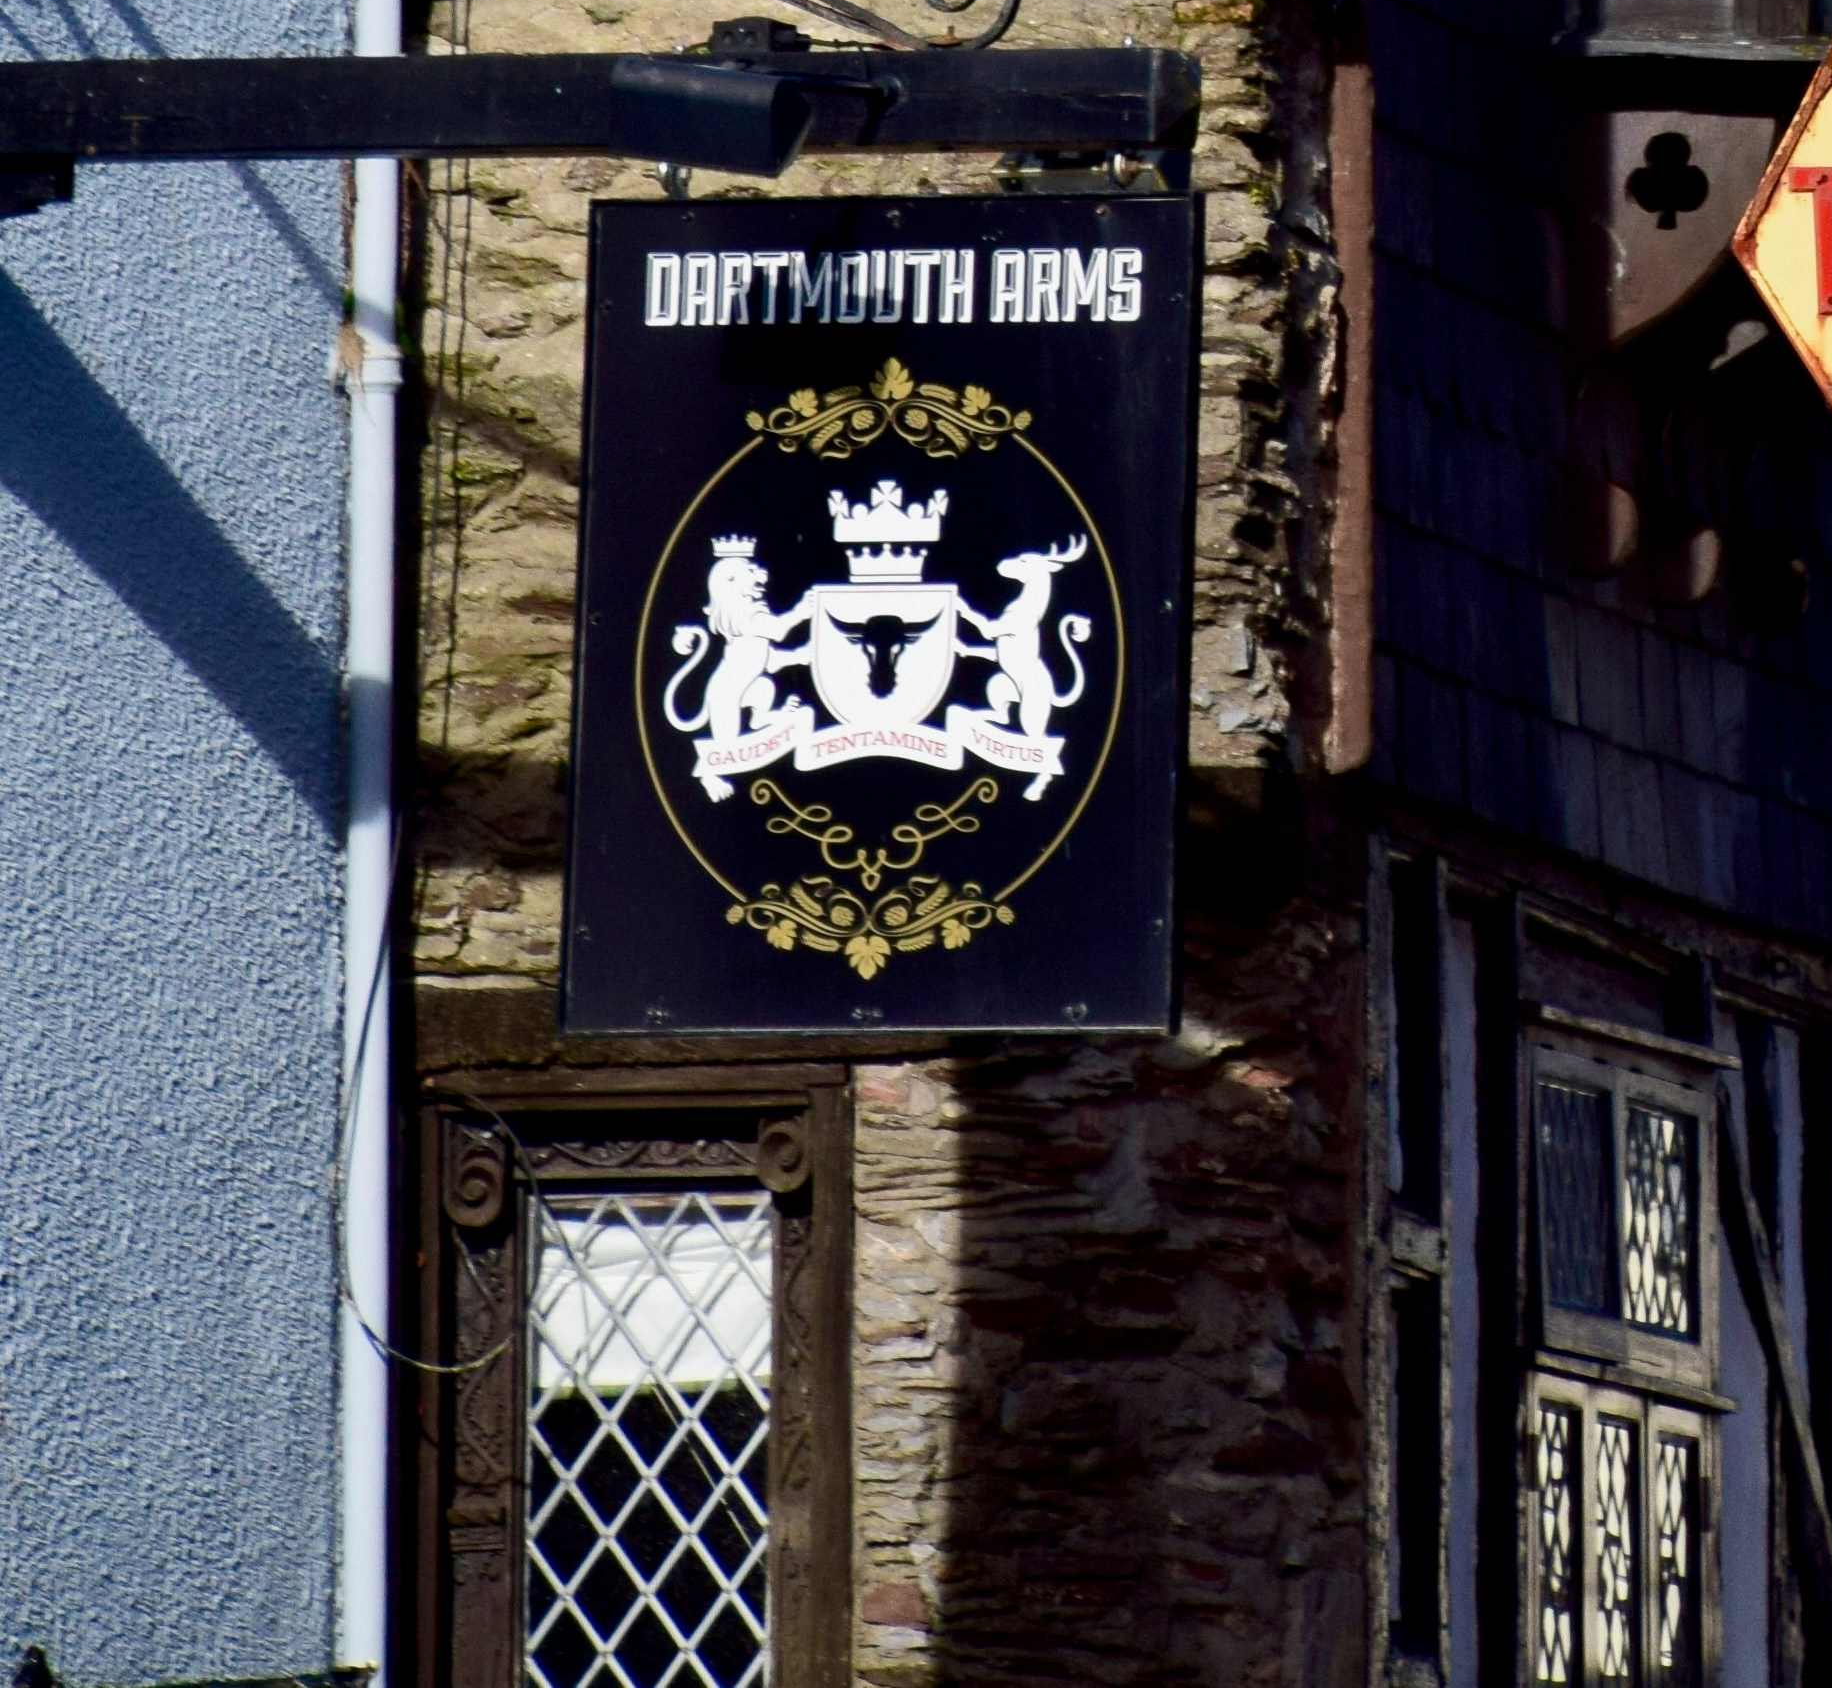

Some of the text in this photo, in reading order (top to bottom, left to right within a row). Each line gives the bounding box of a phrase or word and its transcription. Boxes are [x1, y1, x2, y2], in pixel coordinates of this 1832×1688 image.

[644, 248, 1143, 326] DARTMOUTH ARMS
[811, 730, 948, 759] TENTAMINE
[970, 728, 1045, 763] VIRTUS
